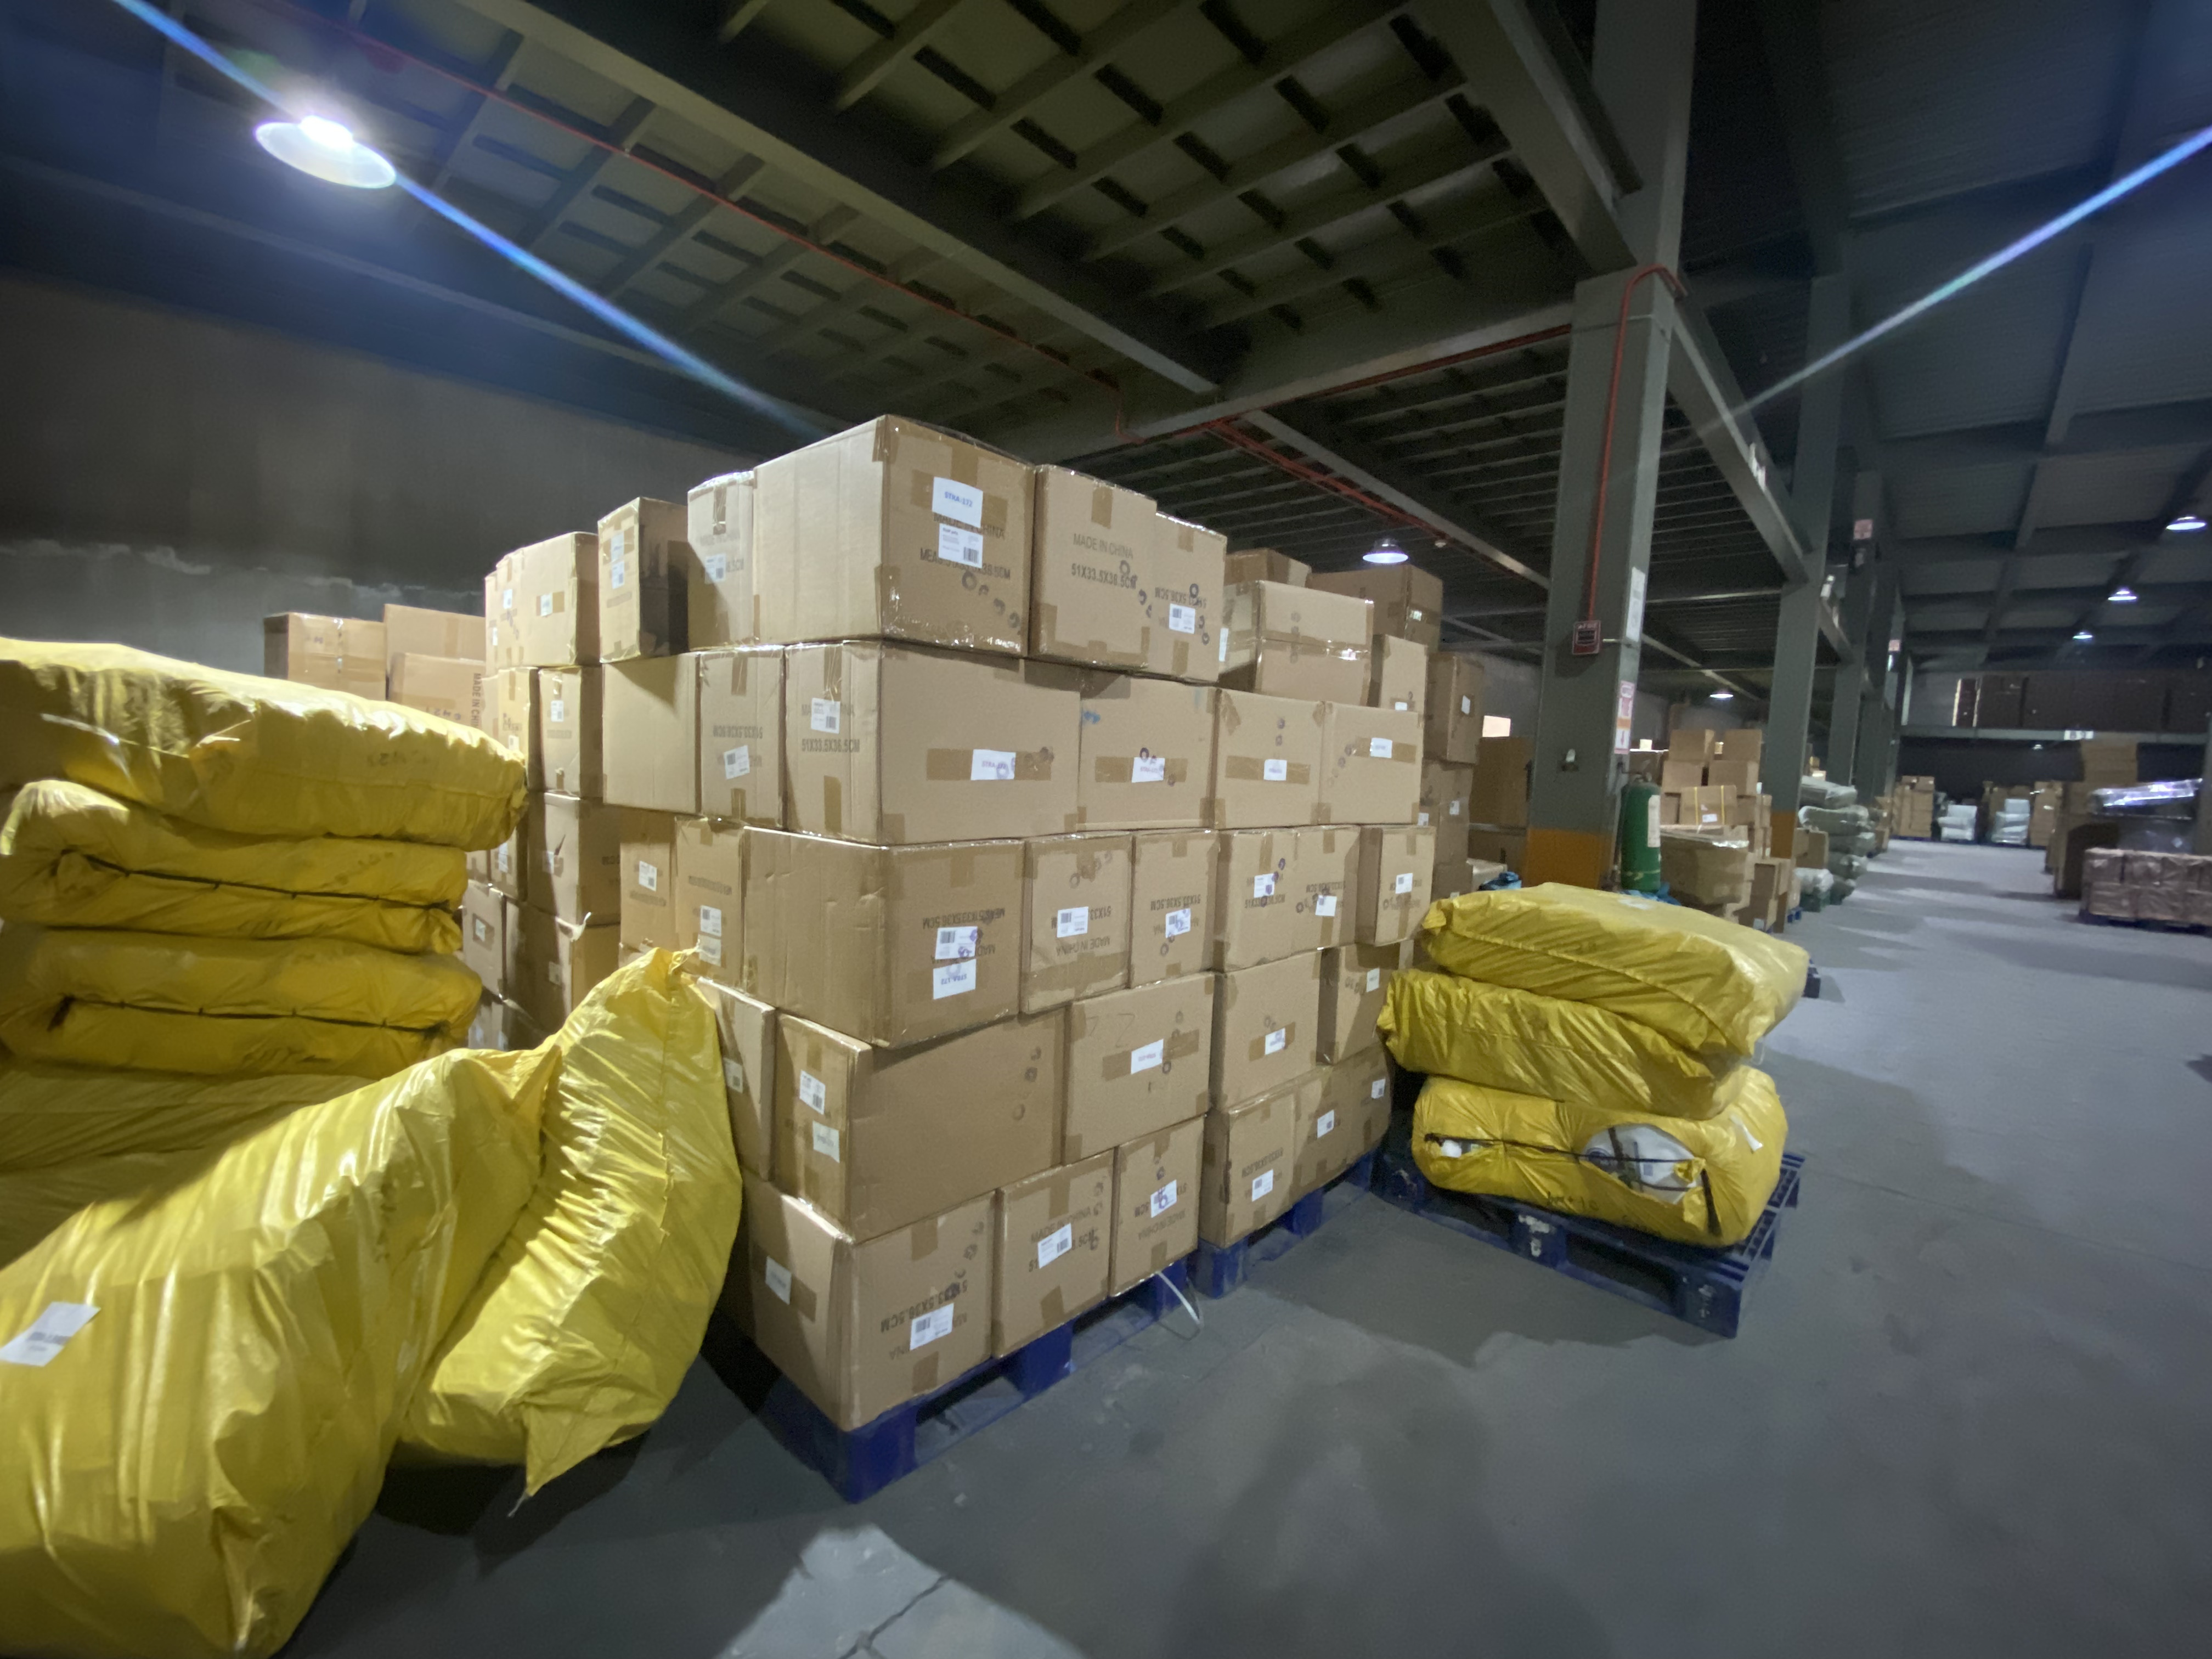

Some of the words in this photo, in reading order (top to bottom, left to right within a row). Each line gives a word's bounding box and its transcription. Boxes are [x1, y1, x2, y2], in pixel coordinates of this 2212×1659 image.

[1073, 533, 1098, 550] MADE
[1099, 540, 1108, 552] IN
[1109, 542, 1133, 559] CHINA
[472, 673, 481, 697] MADE
[472, 698, 480, 708] IN
[470, 709, 479, 729] CHIN
